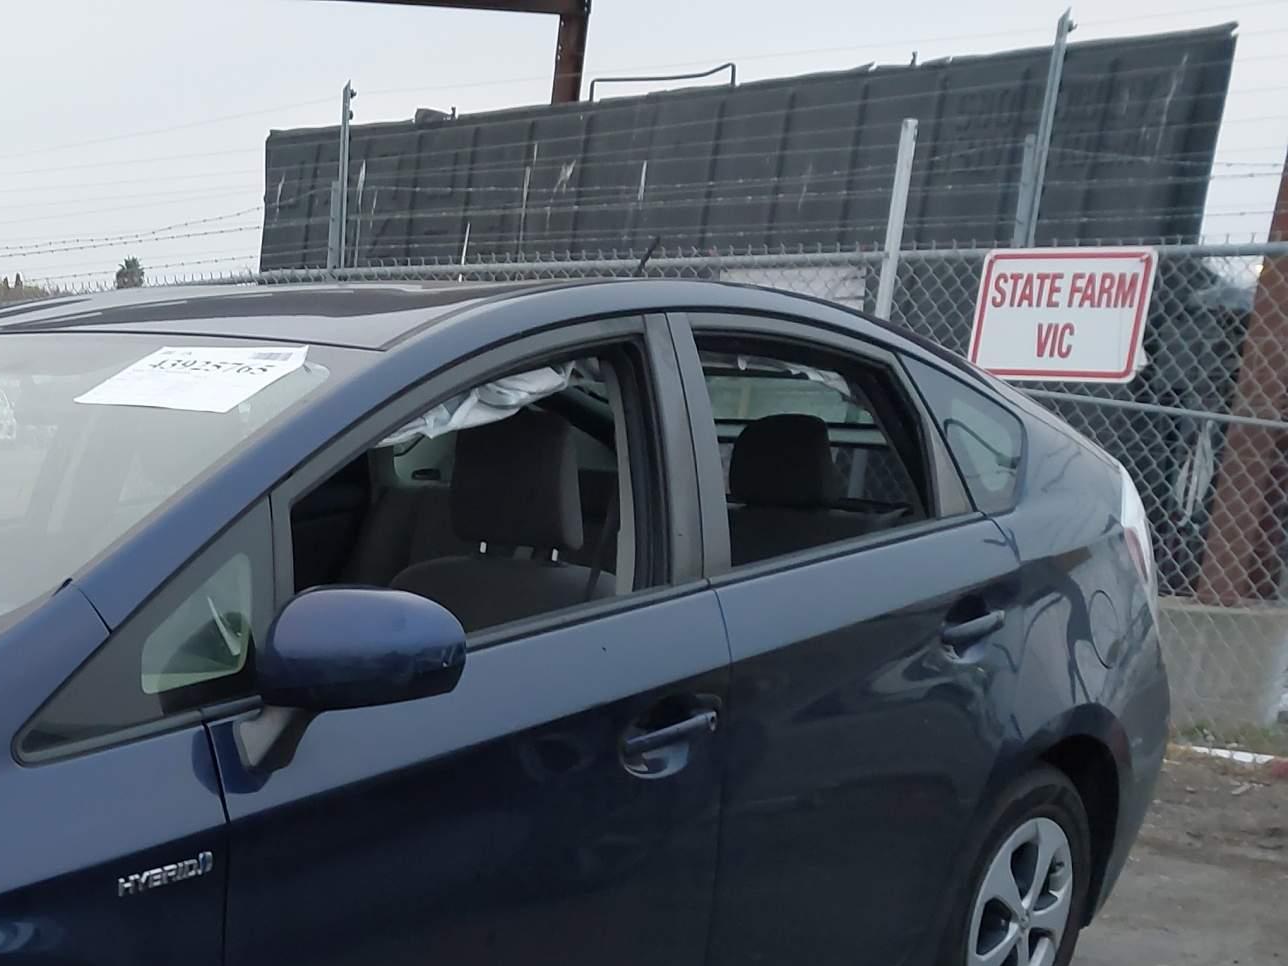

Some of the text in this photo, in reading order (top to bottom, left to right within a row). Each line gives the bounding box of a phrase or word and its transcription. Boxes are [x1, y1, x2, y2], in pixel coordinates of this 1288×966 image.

[991, 272, 1140, 309] STATE FARM
[1035, 322, 1075, 359] VIC
[117, 858, 198, 897] HYBRID
